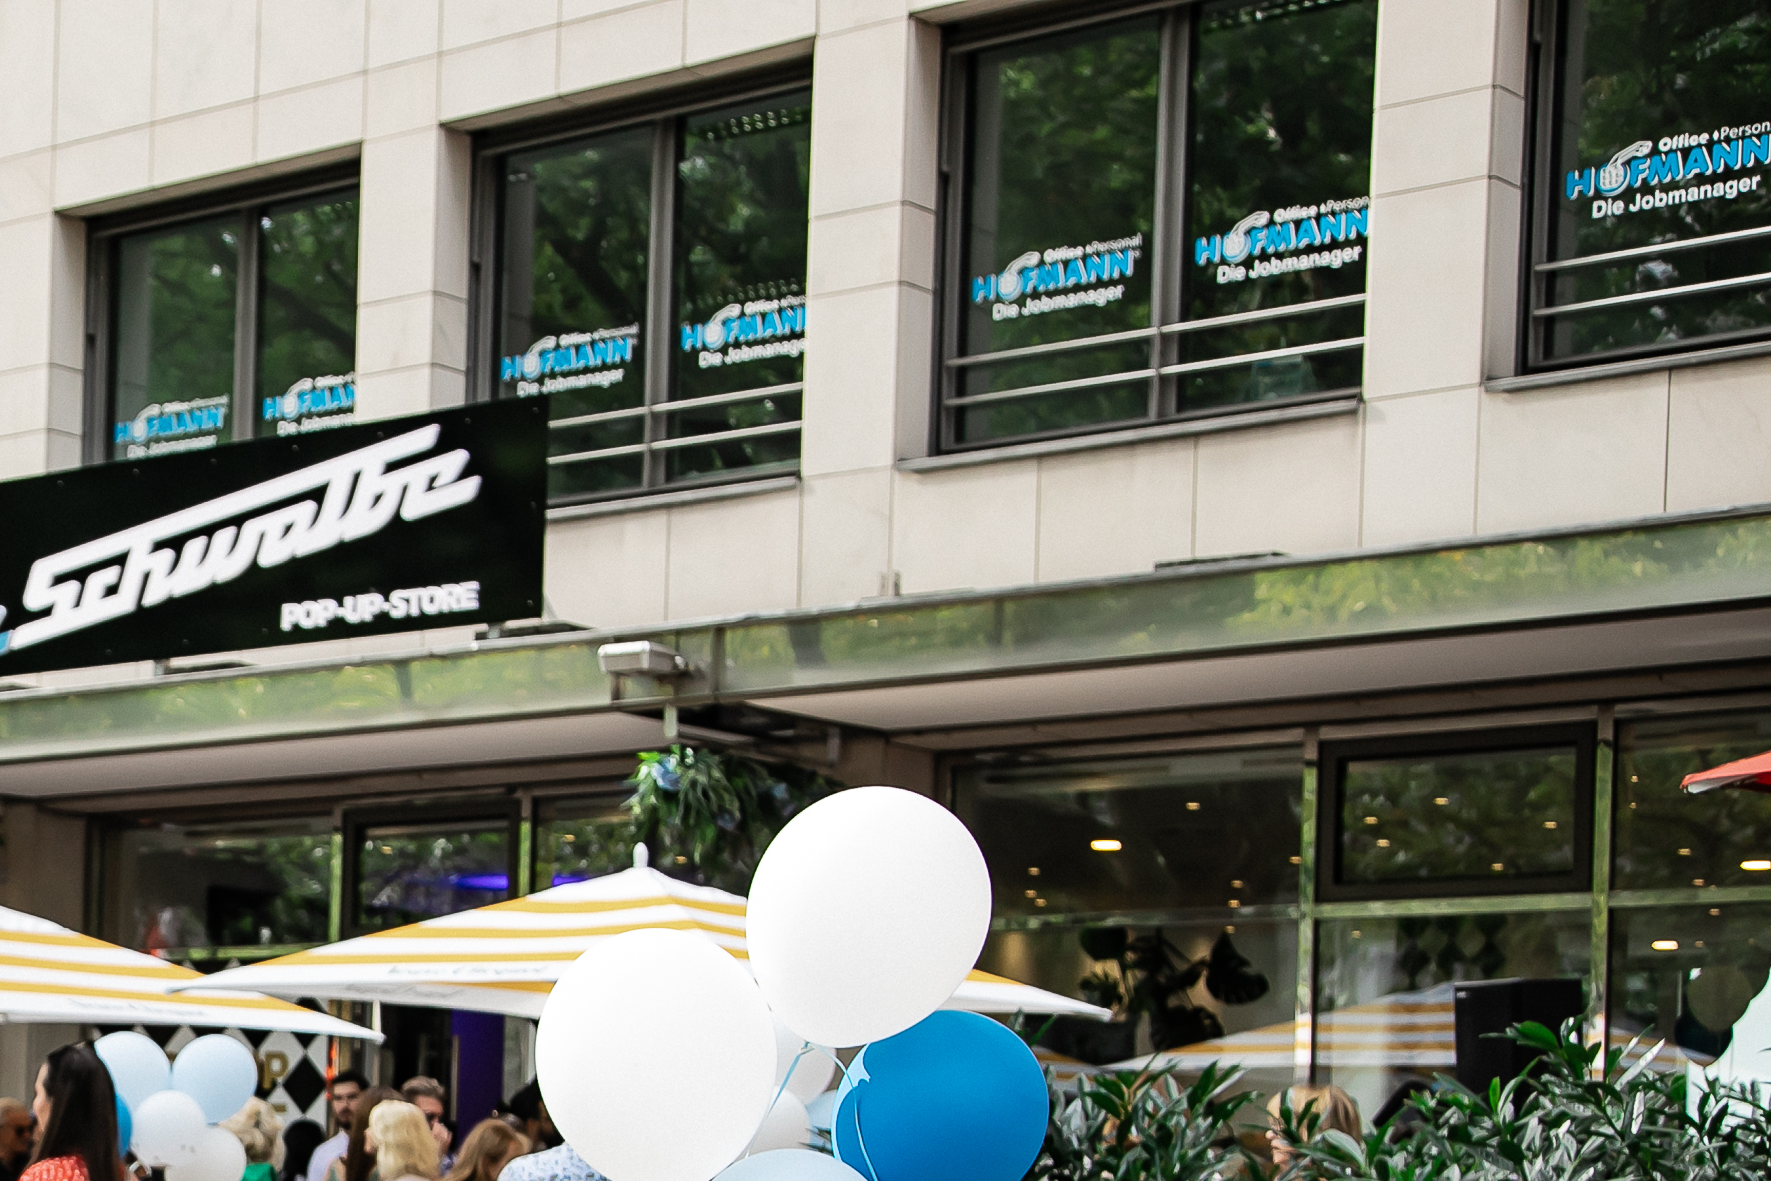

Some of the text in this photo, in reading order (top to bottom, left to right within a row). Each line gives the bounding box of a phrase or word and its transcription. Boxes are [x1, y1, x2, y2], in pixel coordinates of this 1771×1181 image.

[1658, 132, 1710, 152] Office
[1565, 134, 1771, 200] HOFMANN
[1273, 204, 1318, 223] Office
[1592, 175, 1761, 219] Die Jobmanager
[1195, 208, 1368, 266] HOFMANN
[971, 248, 1134, 304] HOFMANN
[1216, 245, 1362, 284] Die Jobmanager
[992, 284, 1125, 321] Die Jobmanager
[681, 305, 806, 352] HOFMAN
[500, 336, 632, 381] HOFMANN
[280, 582, 480, 632] POP-UP-STORE
